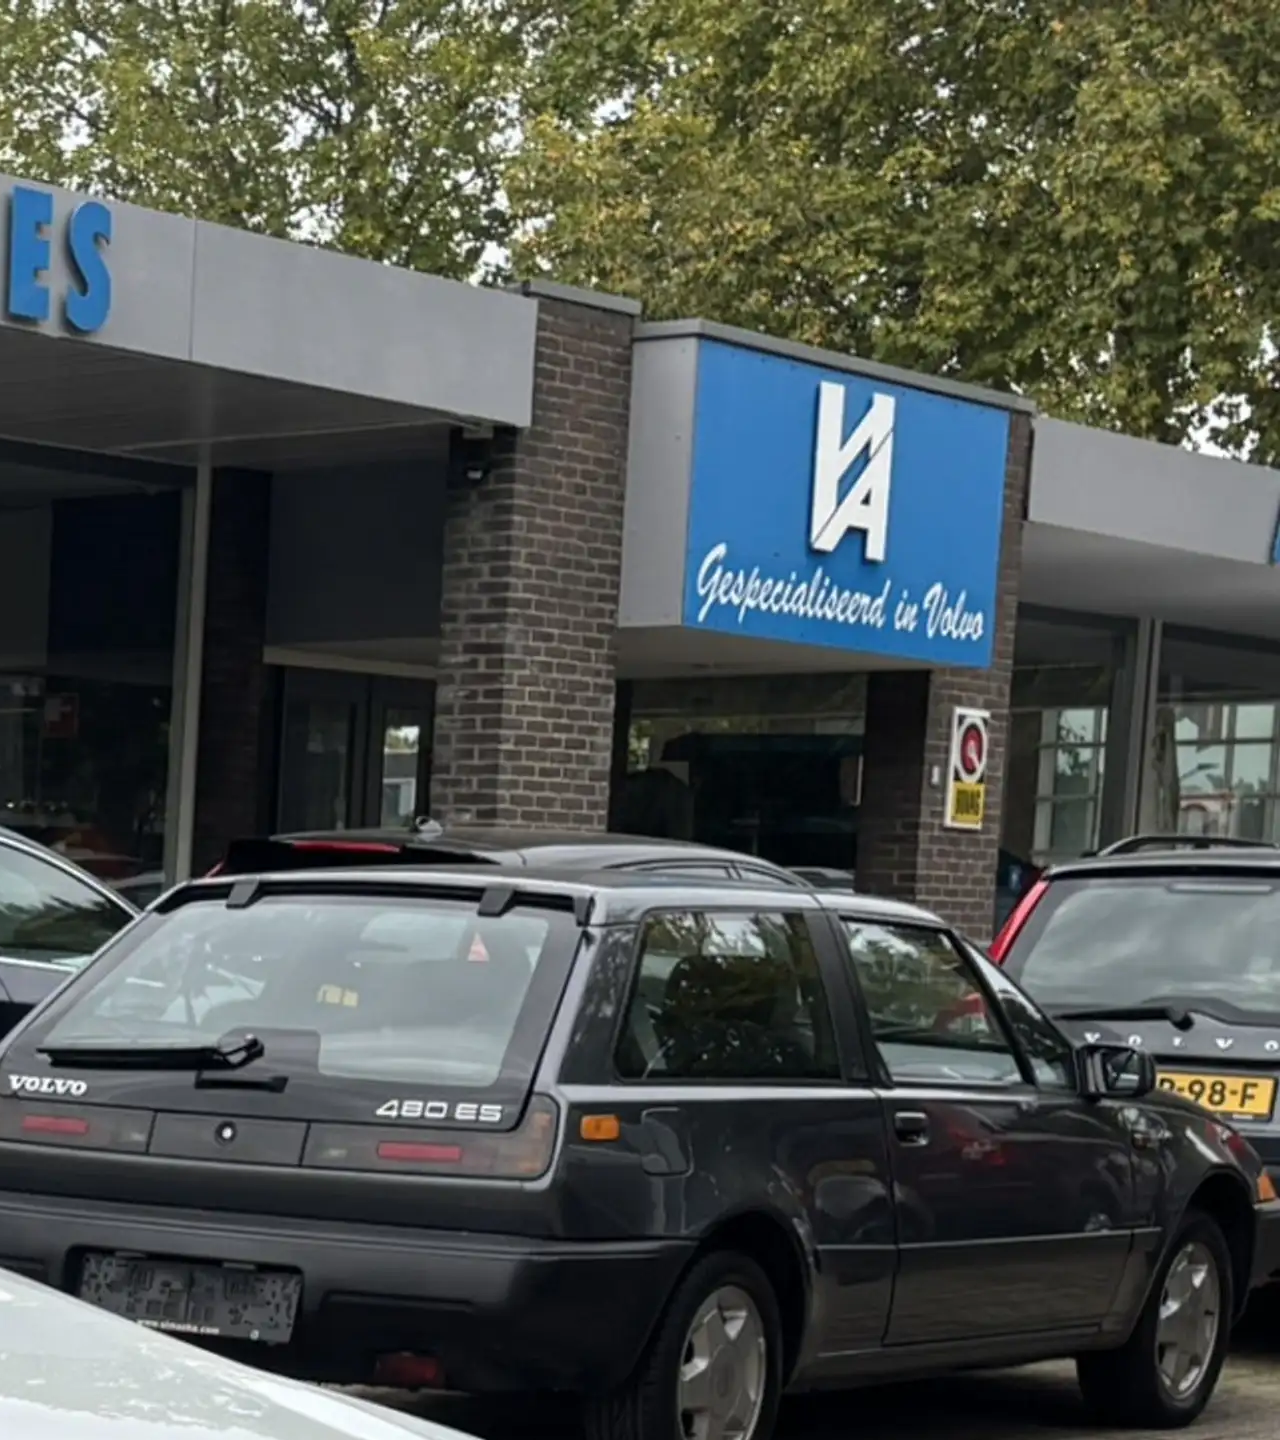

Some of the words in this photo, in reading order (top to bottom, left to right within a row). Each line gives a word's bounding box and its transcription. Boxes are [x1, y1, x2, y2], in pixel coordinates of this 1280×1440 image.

[697, 542, 891, 628] Gespecialiseerd
[894, 589, 918, 633] in
[922, 581, 985, 641] Volvo
[8, 1073, 88, 1097] VOLVO
[375, 1099, 448, 1120] 480
[454, 1102, 503, 1123] ES
